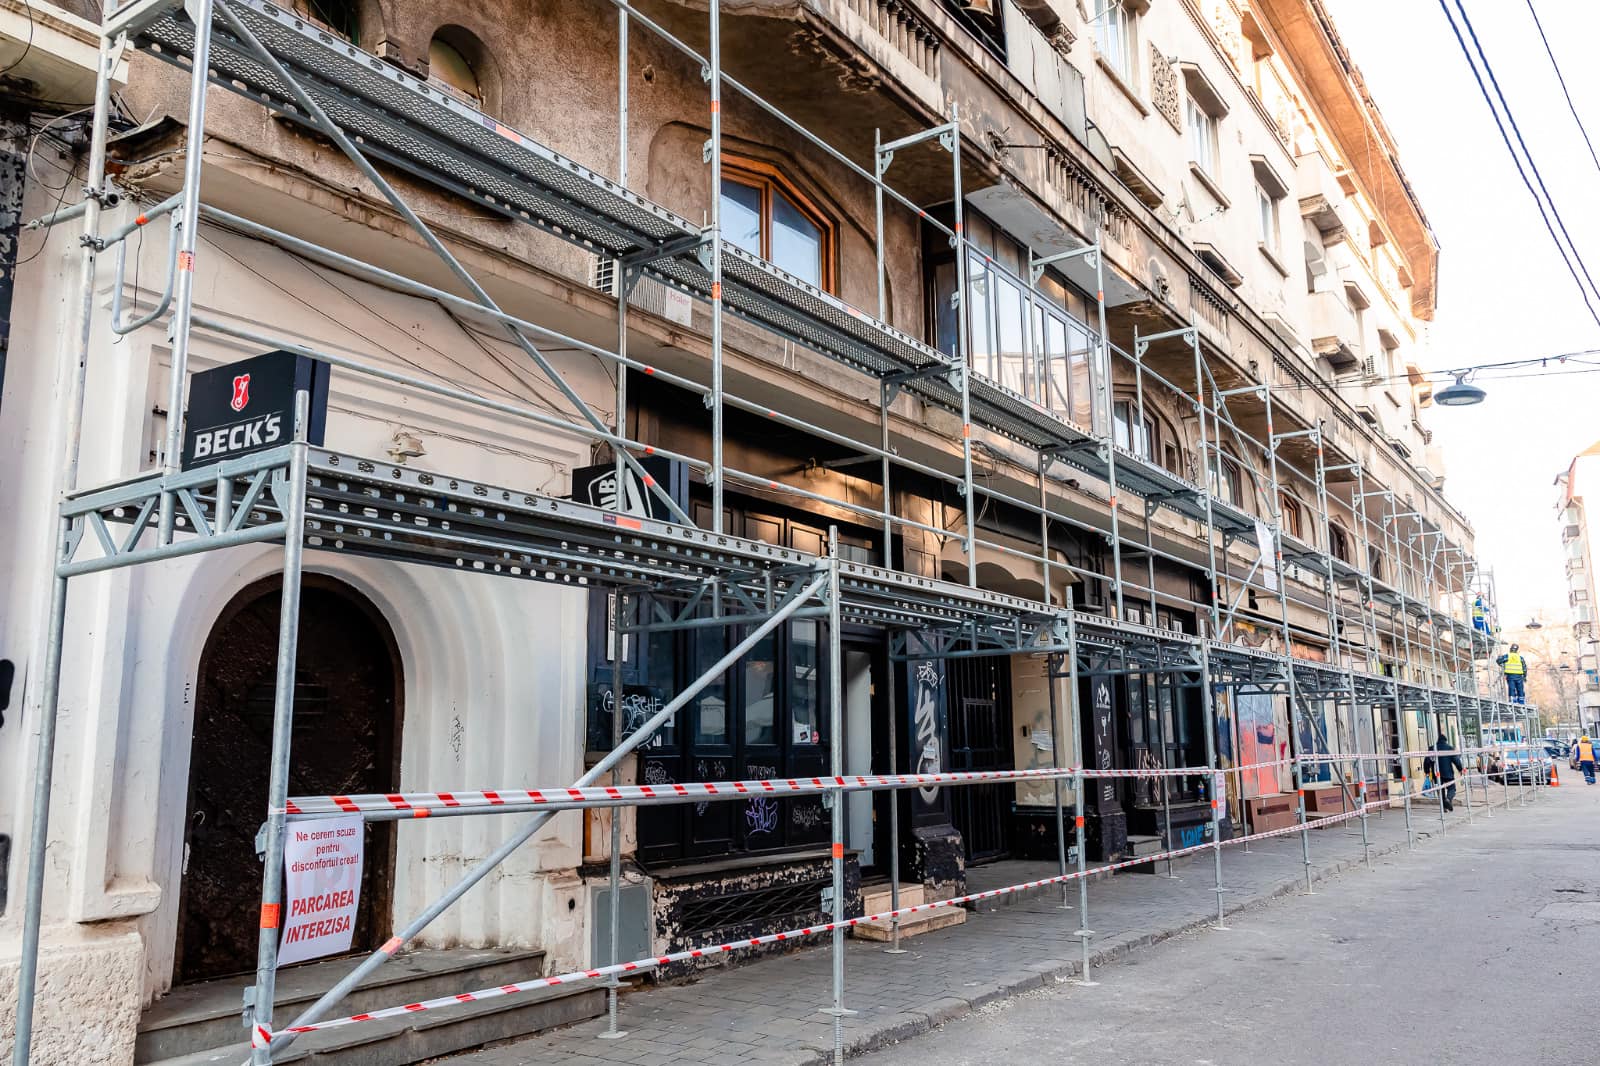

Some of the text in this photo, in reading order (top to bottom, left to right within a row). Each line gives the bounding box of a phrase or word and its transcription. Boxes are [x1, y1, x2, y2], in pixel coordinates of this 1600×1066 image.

[193, 414, 281, 459] BECK'S
[296, 827, 356, 842] Ne cerem scuze
[316, 843, 340, 856] pentru
[291, 857, 338, 873] disconfortul
[291, 888, 354, 917] PARCAREA
[285, 915, 351, 944] INTERZISA
